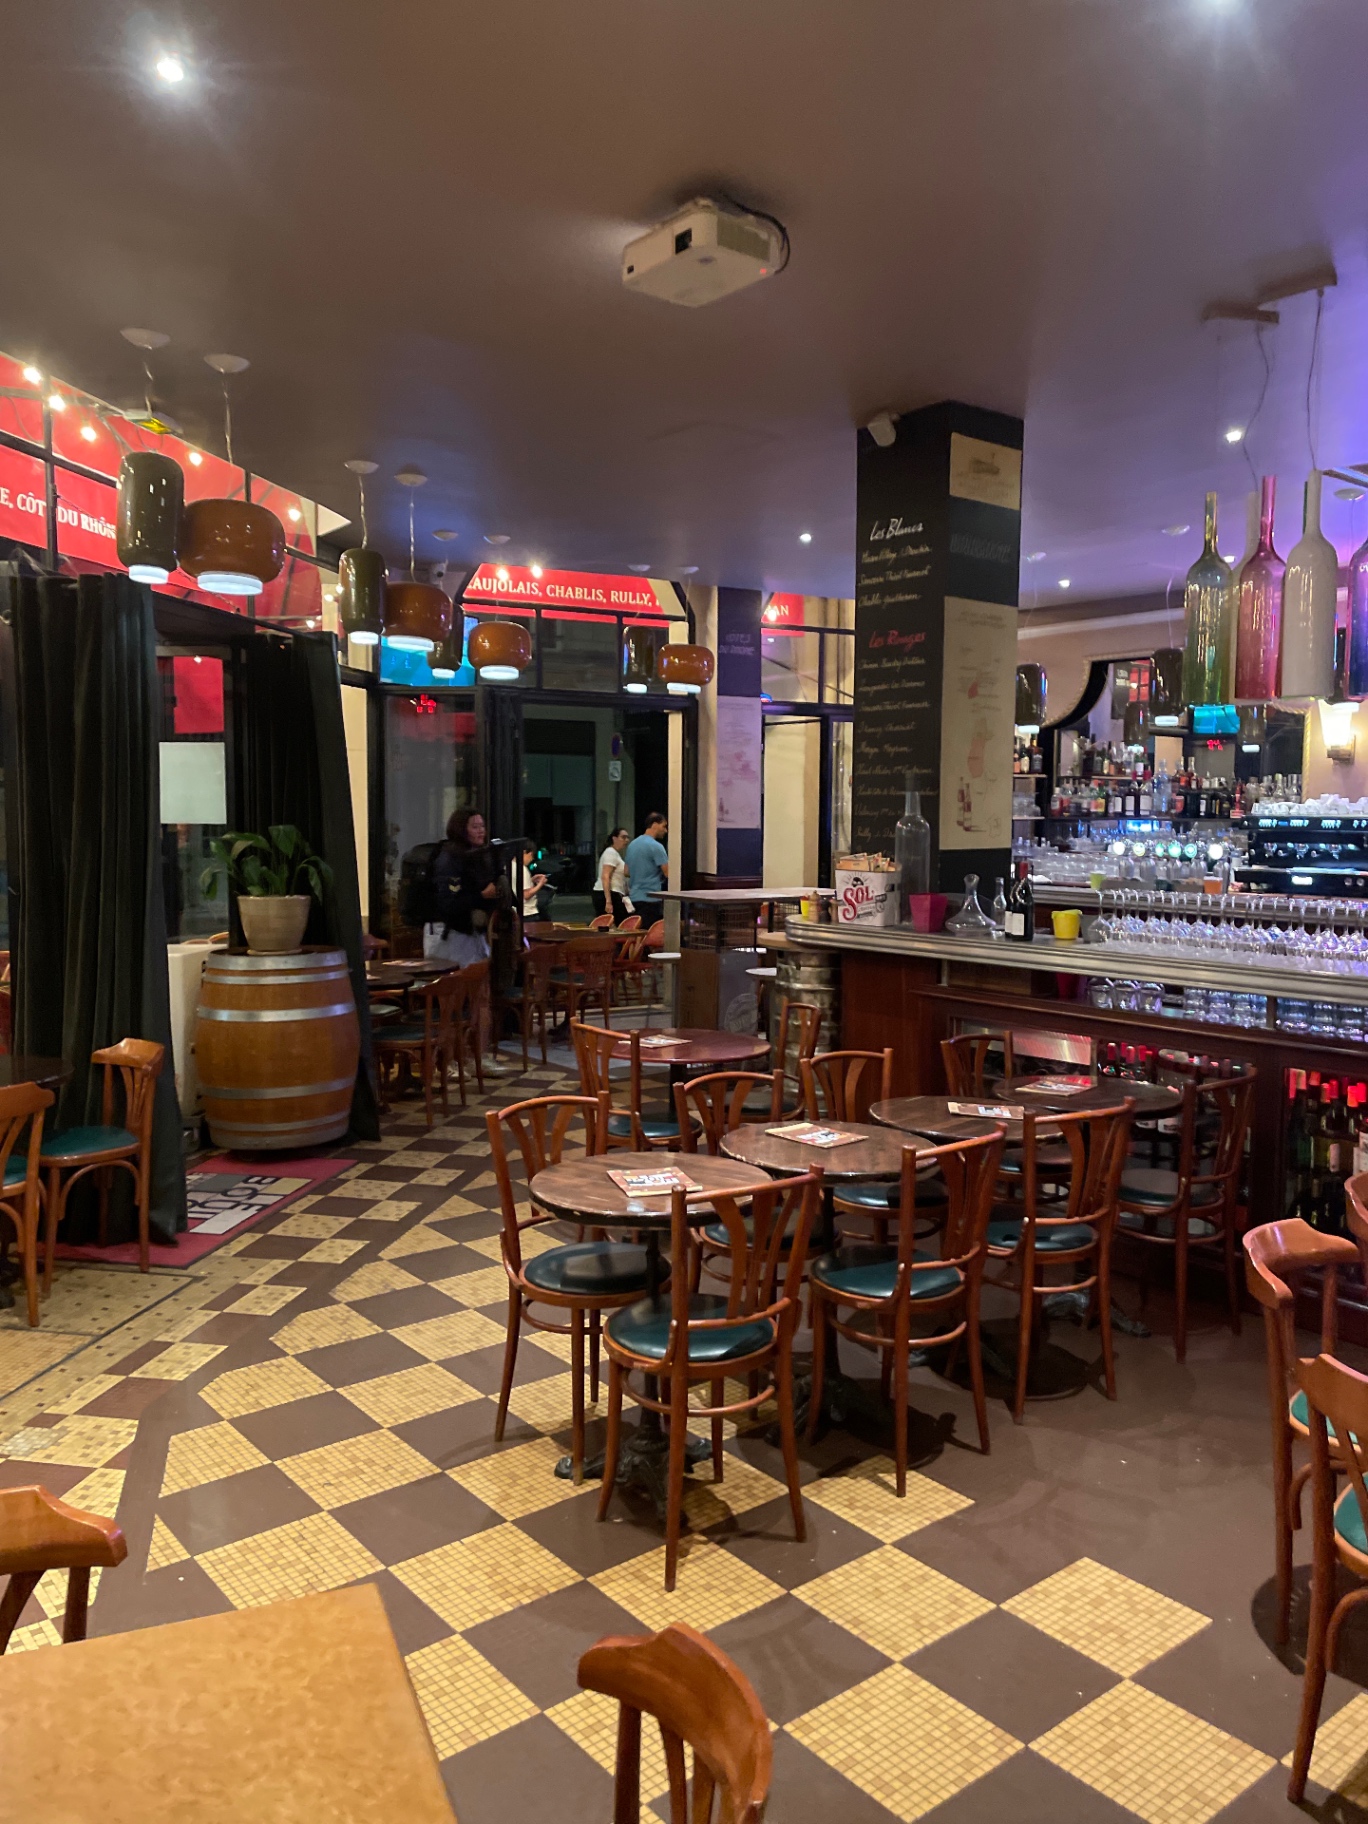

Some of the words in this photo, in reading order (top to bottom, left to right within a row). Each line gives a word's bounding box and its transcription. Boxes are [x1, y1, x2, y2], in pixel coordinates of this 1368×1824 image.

[16, 491, 47, 517] CÔT
[57, 505, 79, 527] DU
[80, 513, 117, 539] RHÔN
[869, 519, 886, 541] Les
[467, 577, 543, 597] AUJOLAIS,
[545, 583, 607, 604] CHABLIS,
[610, 589, 653, 608] RULLY,
[842, 886, 874, 921] SOL
